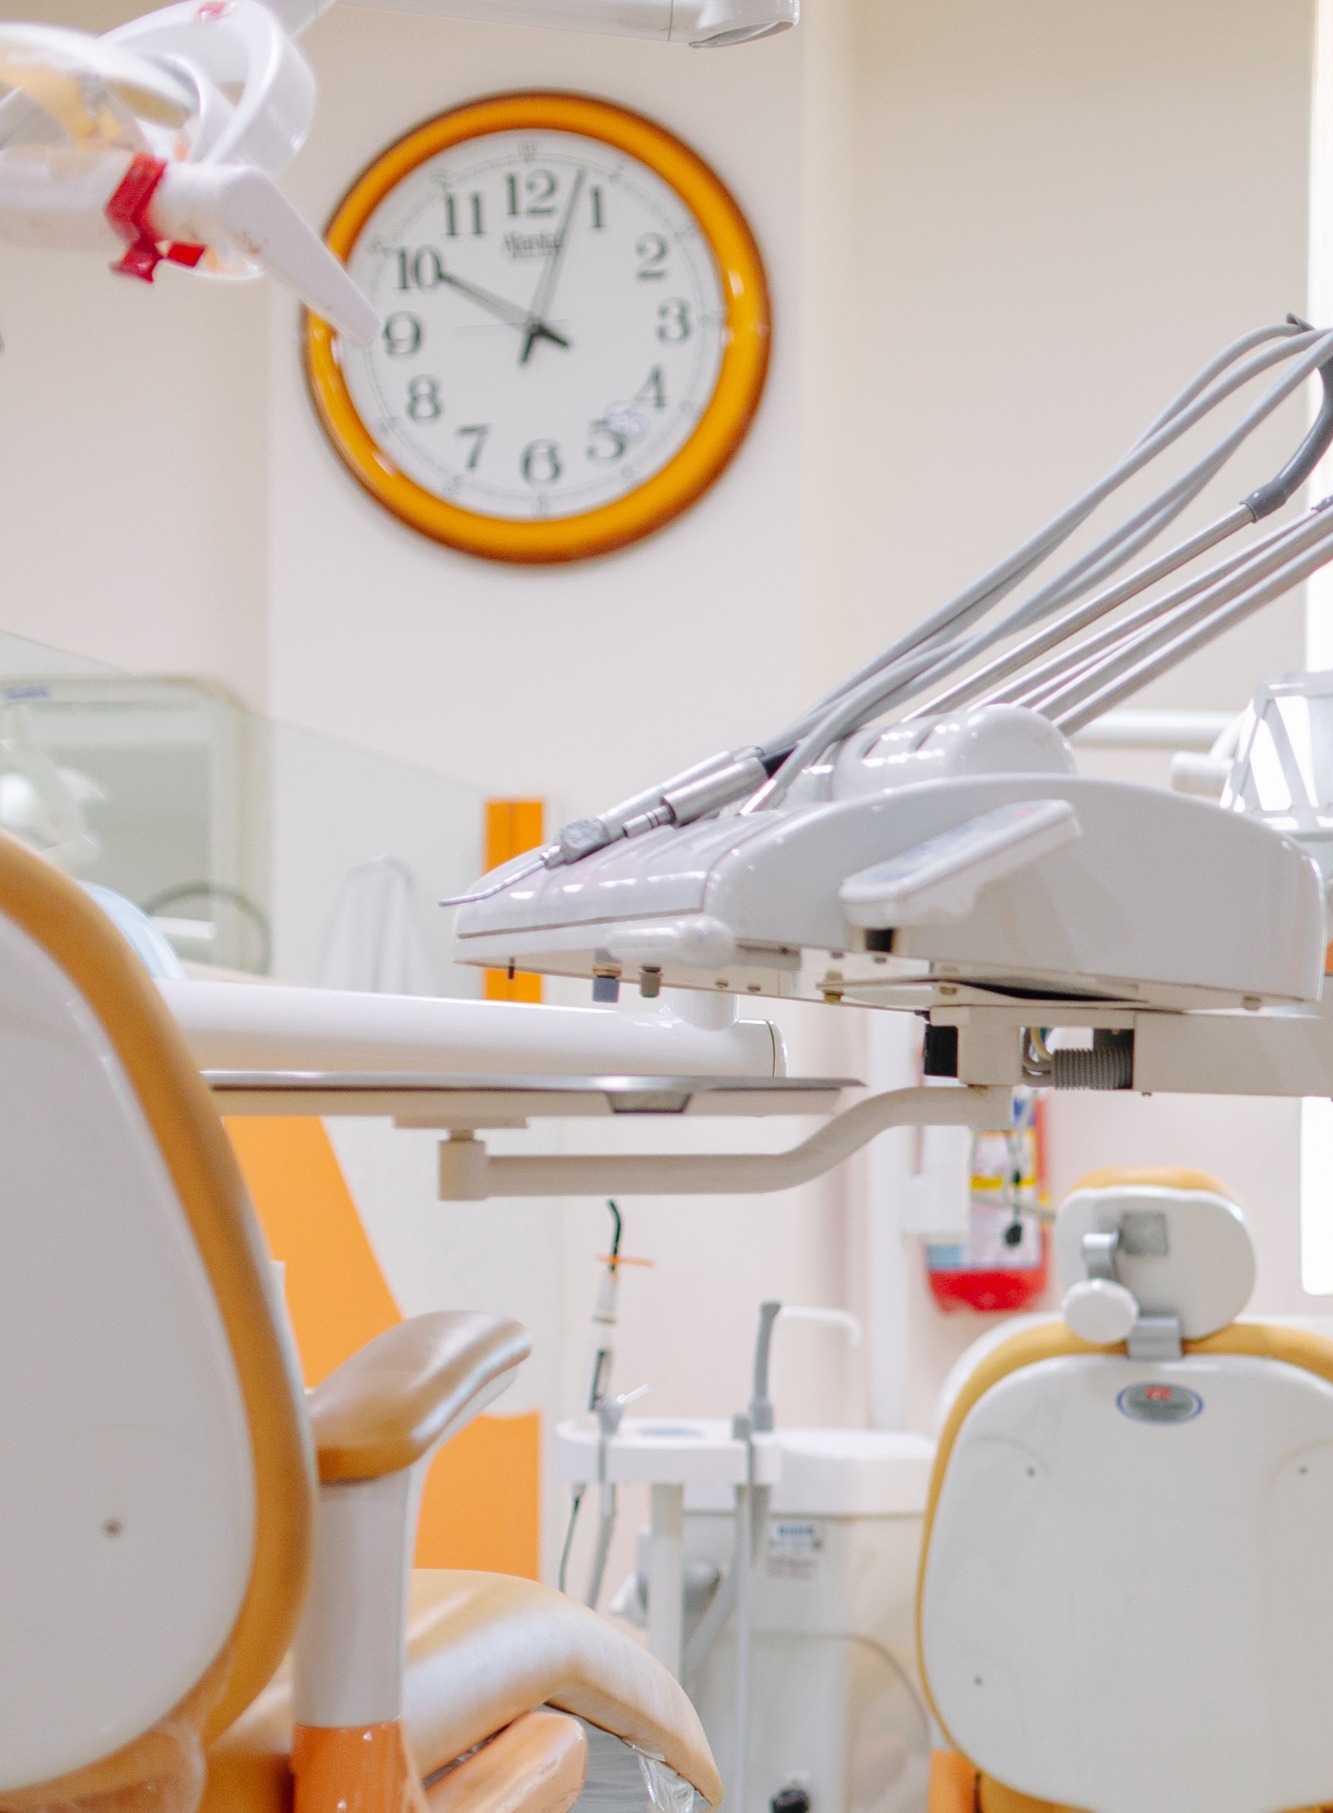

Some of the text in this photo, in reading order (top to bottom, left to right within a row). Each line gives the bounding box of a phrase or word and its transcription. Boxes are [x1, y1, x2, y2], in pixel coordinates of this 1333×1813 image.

[444, 192, 485, 237] 11
[506, 170, 558, 217] 12
[589, 184, 607, 230] 1
[396, 246, 442, 291] 10
[635, 232, 668, 281] 2
[383, 310, 423, 357] 9
[656, 297, 692, 344] 3
[406, 374, 442, 422] 8
[633, 364, 667, 411] 4
[456, 424, 491, 470] 7
[521, 438, 562, 485] 6
[586, 418, 626, 463] 5
